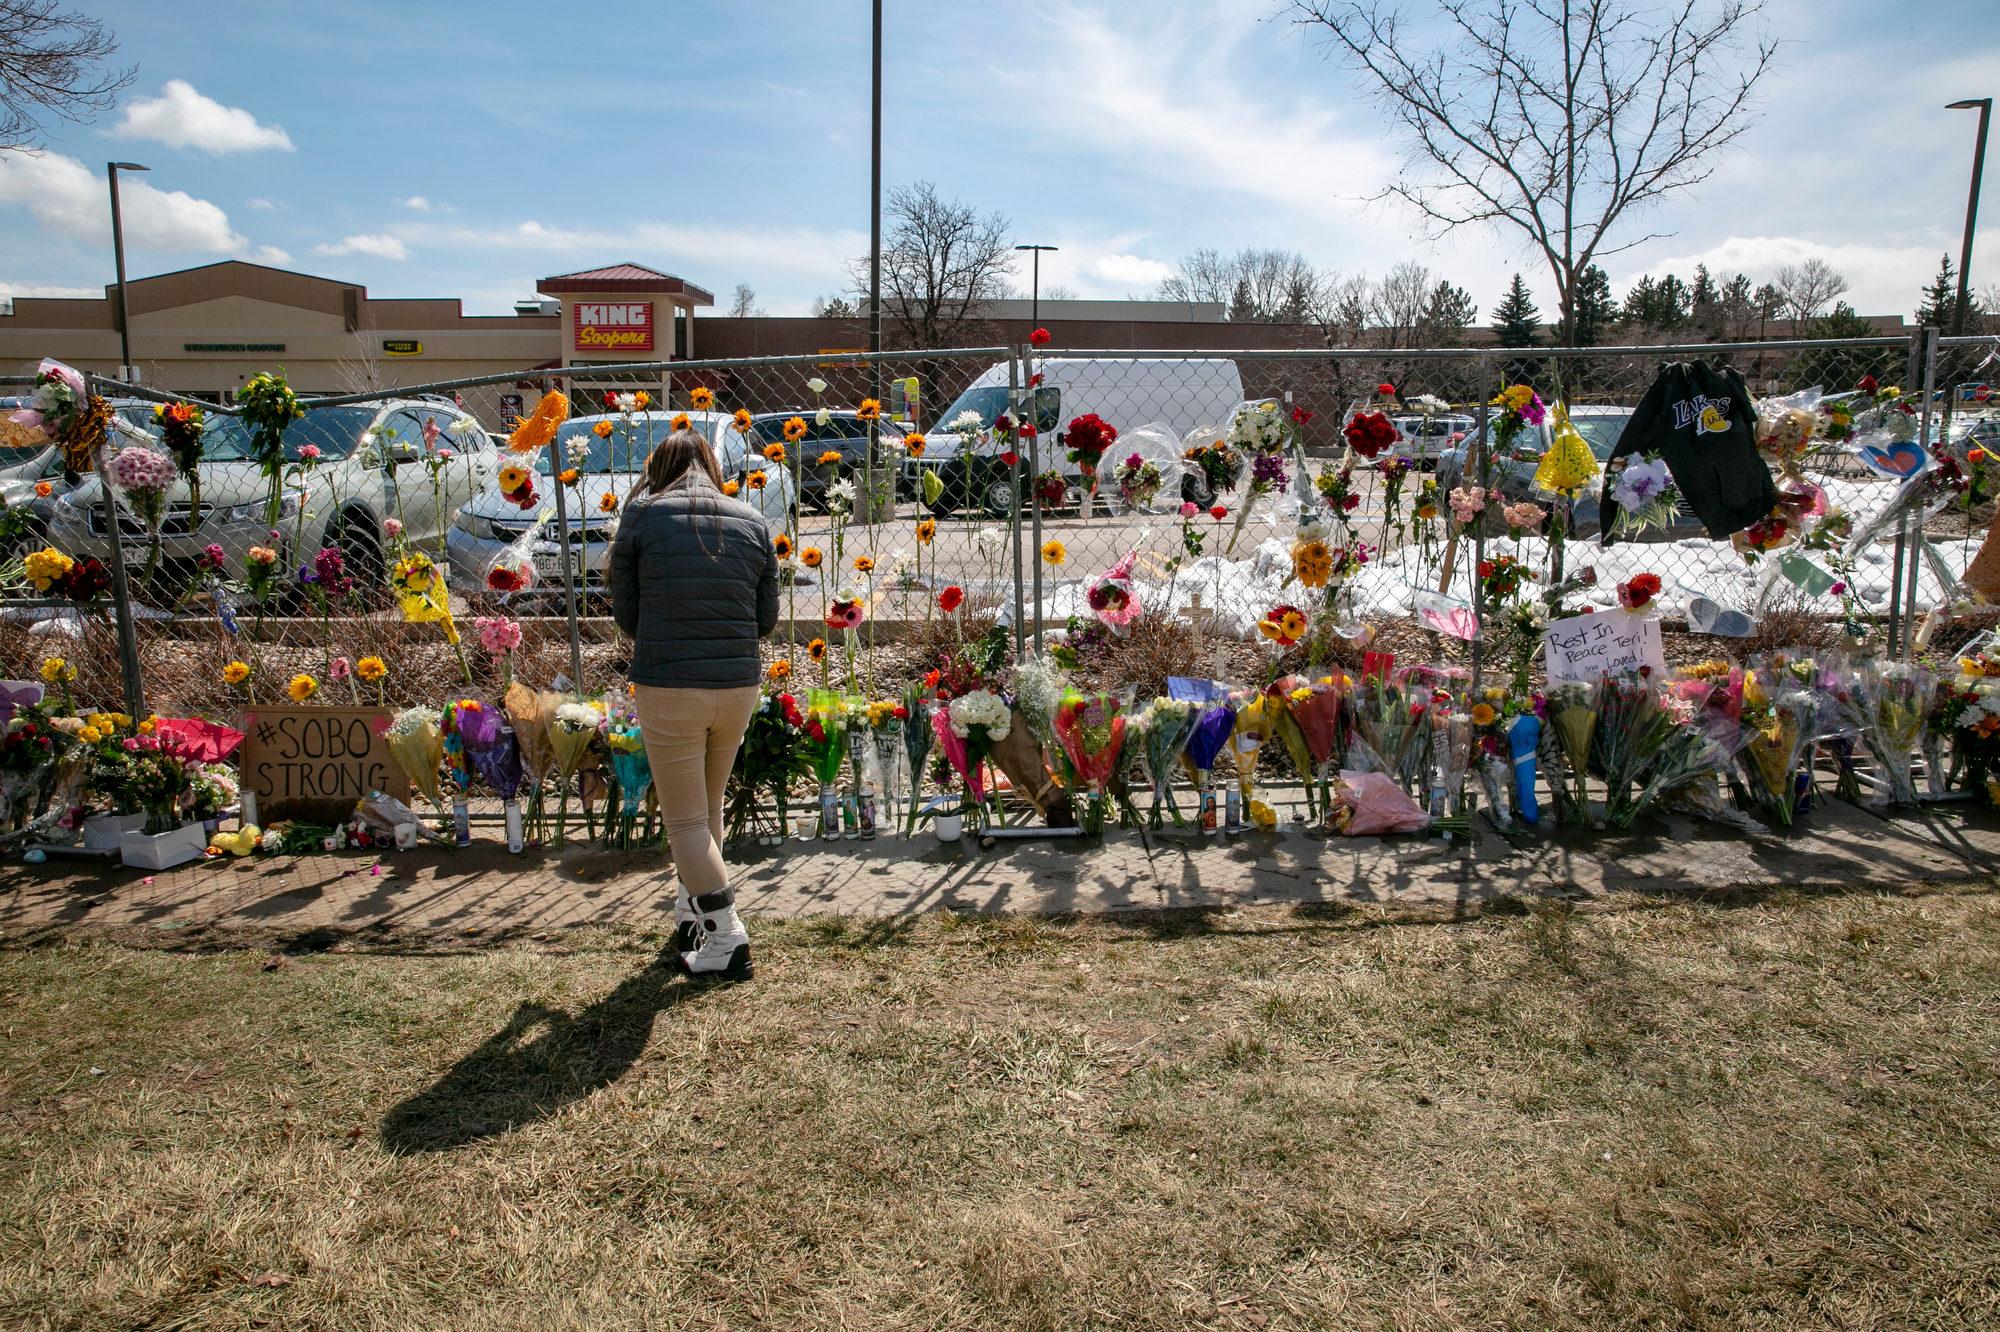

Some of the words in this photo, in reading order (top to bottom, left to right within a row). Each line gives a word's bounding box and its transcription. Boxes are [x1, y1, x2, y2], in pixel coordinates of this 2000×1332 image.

[580, 305, 645, 326] KING
[579, 326, 646, 349] Soopers
[1548, 626, 1589, 655] Rest
[1592, 622, 1614, 641] In
[1565, 644, 1608, 663] Peace
[257, 717, 371, 758] #SOBO
[257, 762, 390, 798] STRONG
